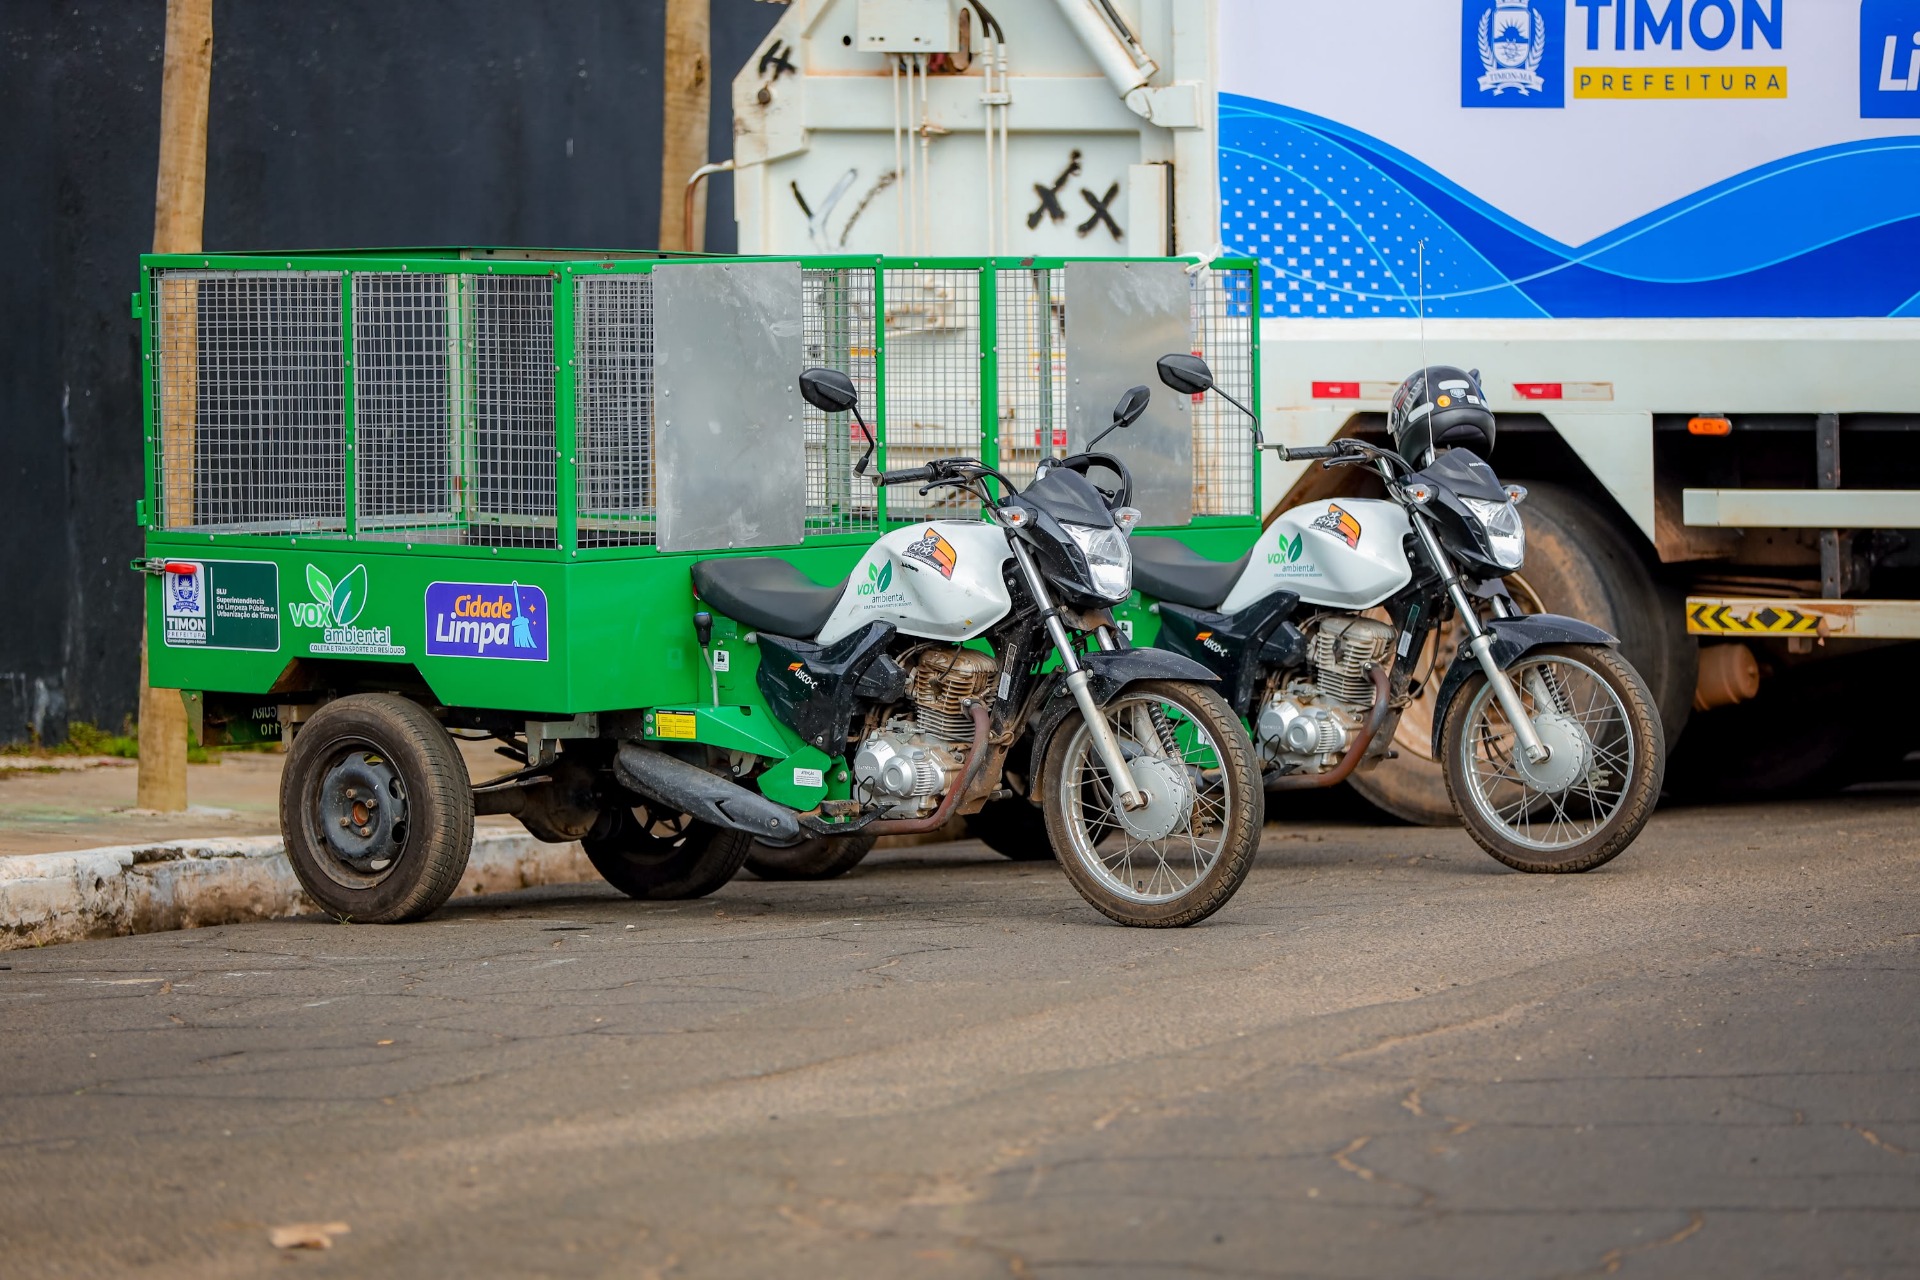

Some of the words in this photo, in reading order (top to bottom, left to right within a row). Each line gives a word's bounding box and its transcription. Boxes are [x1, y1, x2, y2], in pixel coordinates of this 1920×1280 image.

[1575, 0, 1783, 51] TIMON
[1580, 74, 1780, 91] PREFEITURA
[1267, 552, 1286, 565] VOX
[1281, 563, 1316, 573] ambiental
[857, 583, 876, 596] VOX
[216, 596, 265, 605] Superintendência
[871, 592, 906, 604] ambiental
[216, 602, 224, 610] de
[224, 603, 248, 612] Limpeza
[454, 594, 513, 619] Cidade
[251, 611, 259, 619] de
[259, 612, 278, 620] Timon
[288, 602, 332, 627] VOX
[166, 617, 207, 631] TIMON
[167, 631, 206, 639] PREFEITURA
[324, 624, 391, 646] ambiental
[436, 612, 511, 654] Limpa
[310, 644, 330, 652] COLETA
[334, 645, 369, 653] TRANSPORTE
